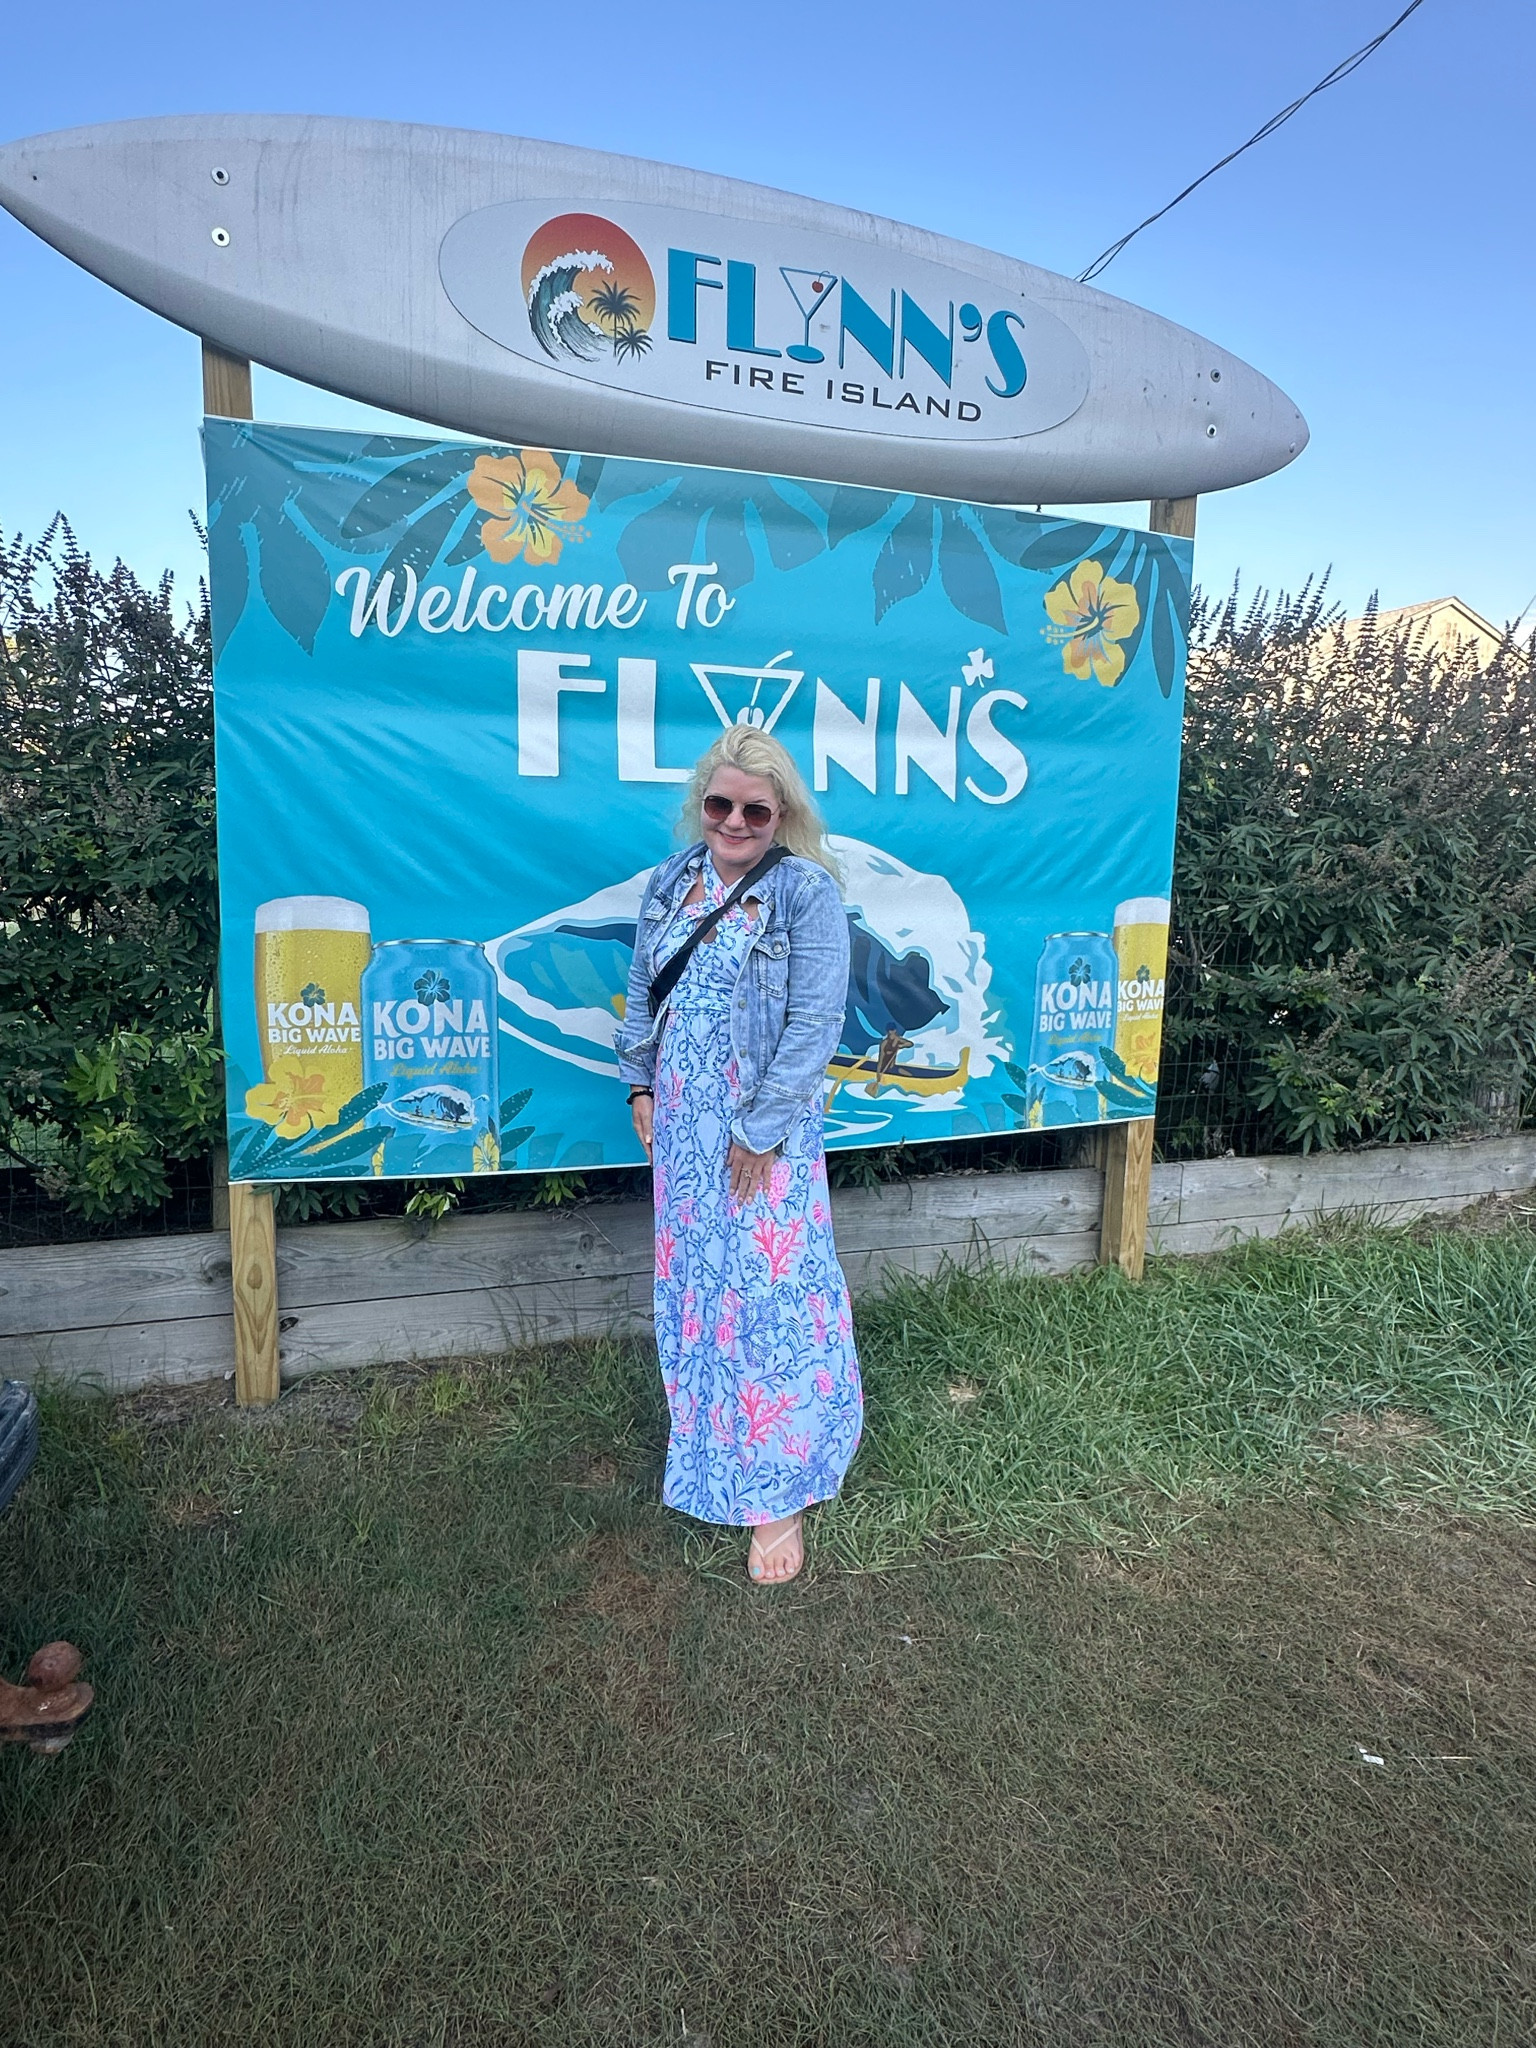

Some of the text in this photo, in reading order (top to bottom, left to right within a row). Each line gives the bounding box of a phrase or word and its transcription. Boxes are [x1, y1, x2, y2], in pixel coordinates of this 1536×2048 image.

[668, 248, 1028, 398] FLYNN'S
[705, 360, 982, 422] FIRE ISLAND
[334, 562, 736, 639] Welcome To
[1041, 981, 1112, 1013] KONA
[1117, 979, 1165, 1000] KONA
[267, 1002, 359, 1028] KONA
[373, 999, 489, 1038] KONA
[1117, 1000, 1134, 1012] BIG
[1039, 1012, 1066, 1033] BIG
[1069, 1010, 1112, 1030] WAVE
[268, 1027, 361, 1043] BIG WAVE
[283, 1044, 348, 1057] Liquid Aloha
[373, 1036, 491, 1060] BIG WAVE
